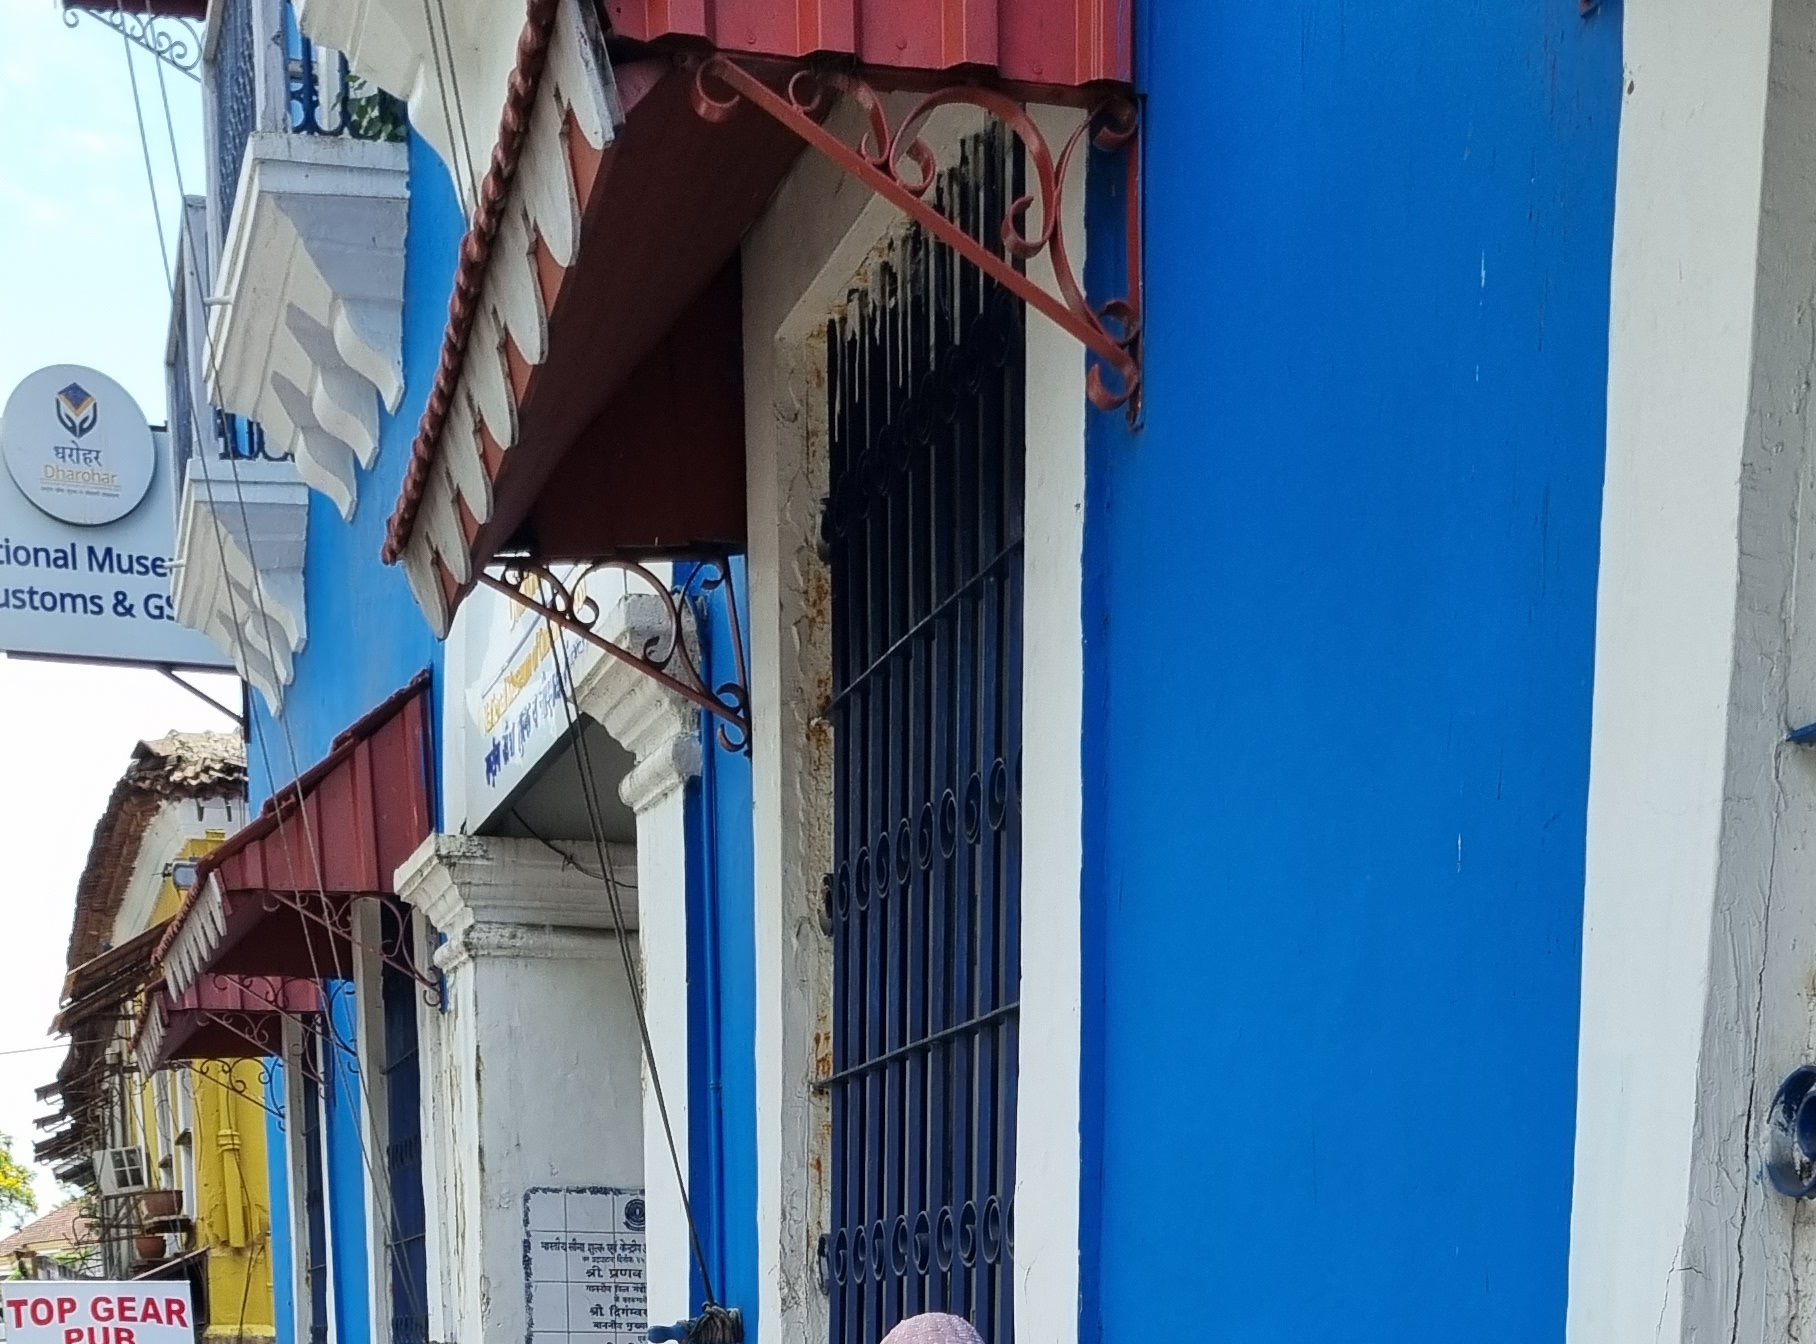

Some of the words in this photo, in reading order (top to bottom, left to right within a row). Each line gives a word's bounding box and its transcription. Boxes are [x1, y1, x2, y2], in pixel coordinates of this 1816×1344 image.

[43, 464, 118, 485] Dharohar
[112, 591, 136, 618] &
[608, 1268, 642, 1279] प्रणव
[7, 1297, 77, 1328] TOP
[90, 1296, 189, 1328] GEAR
